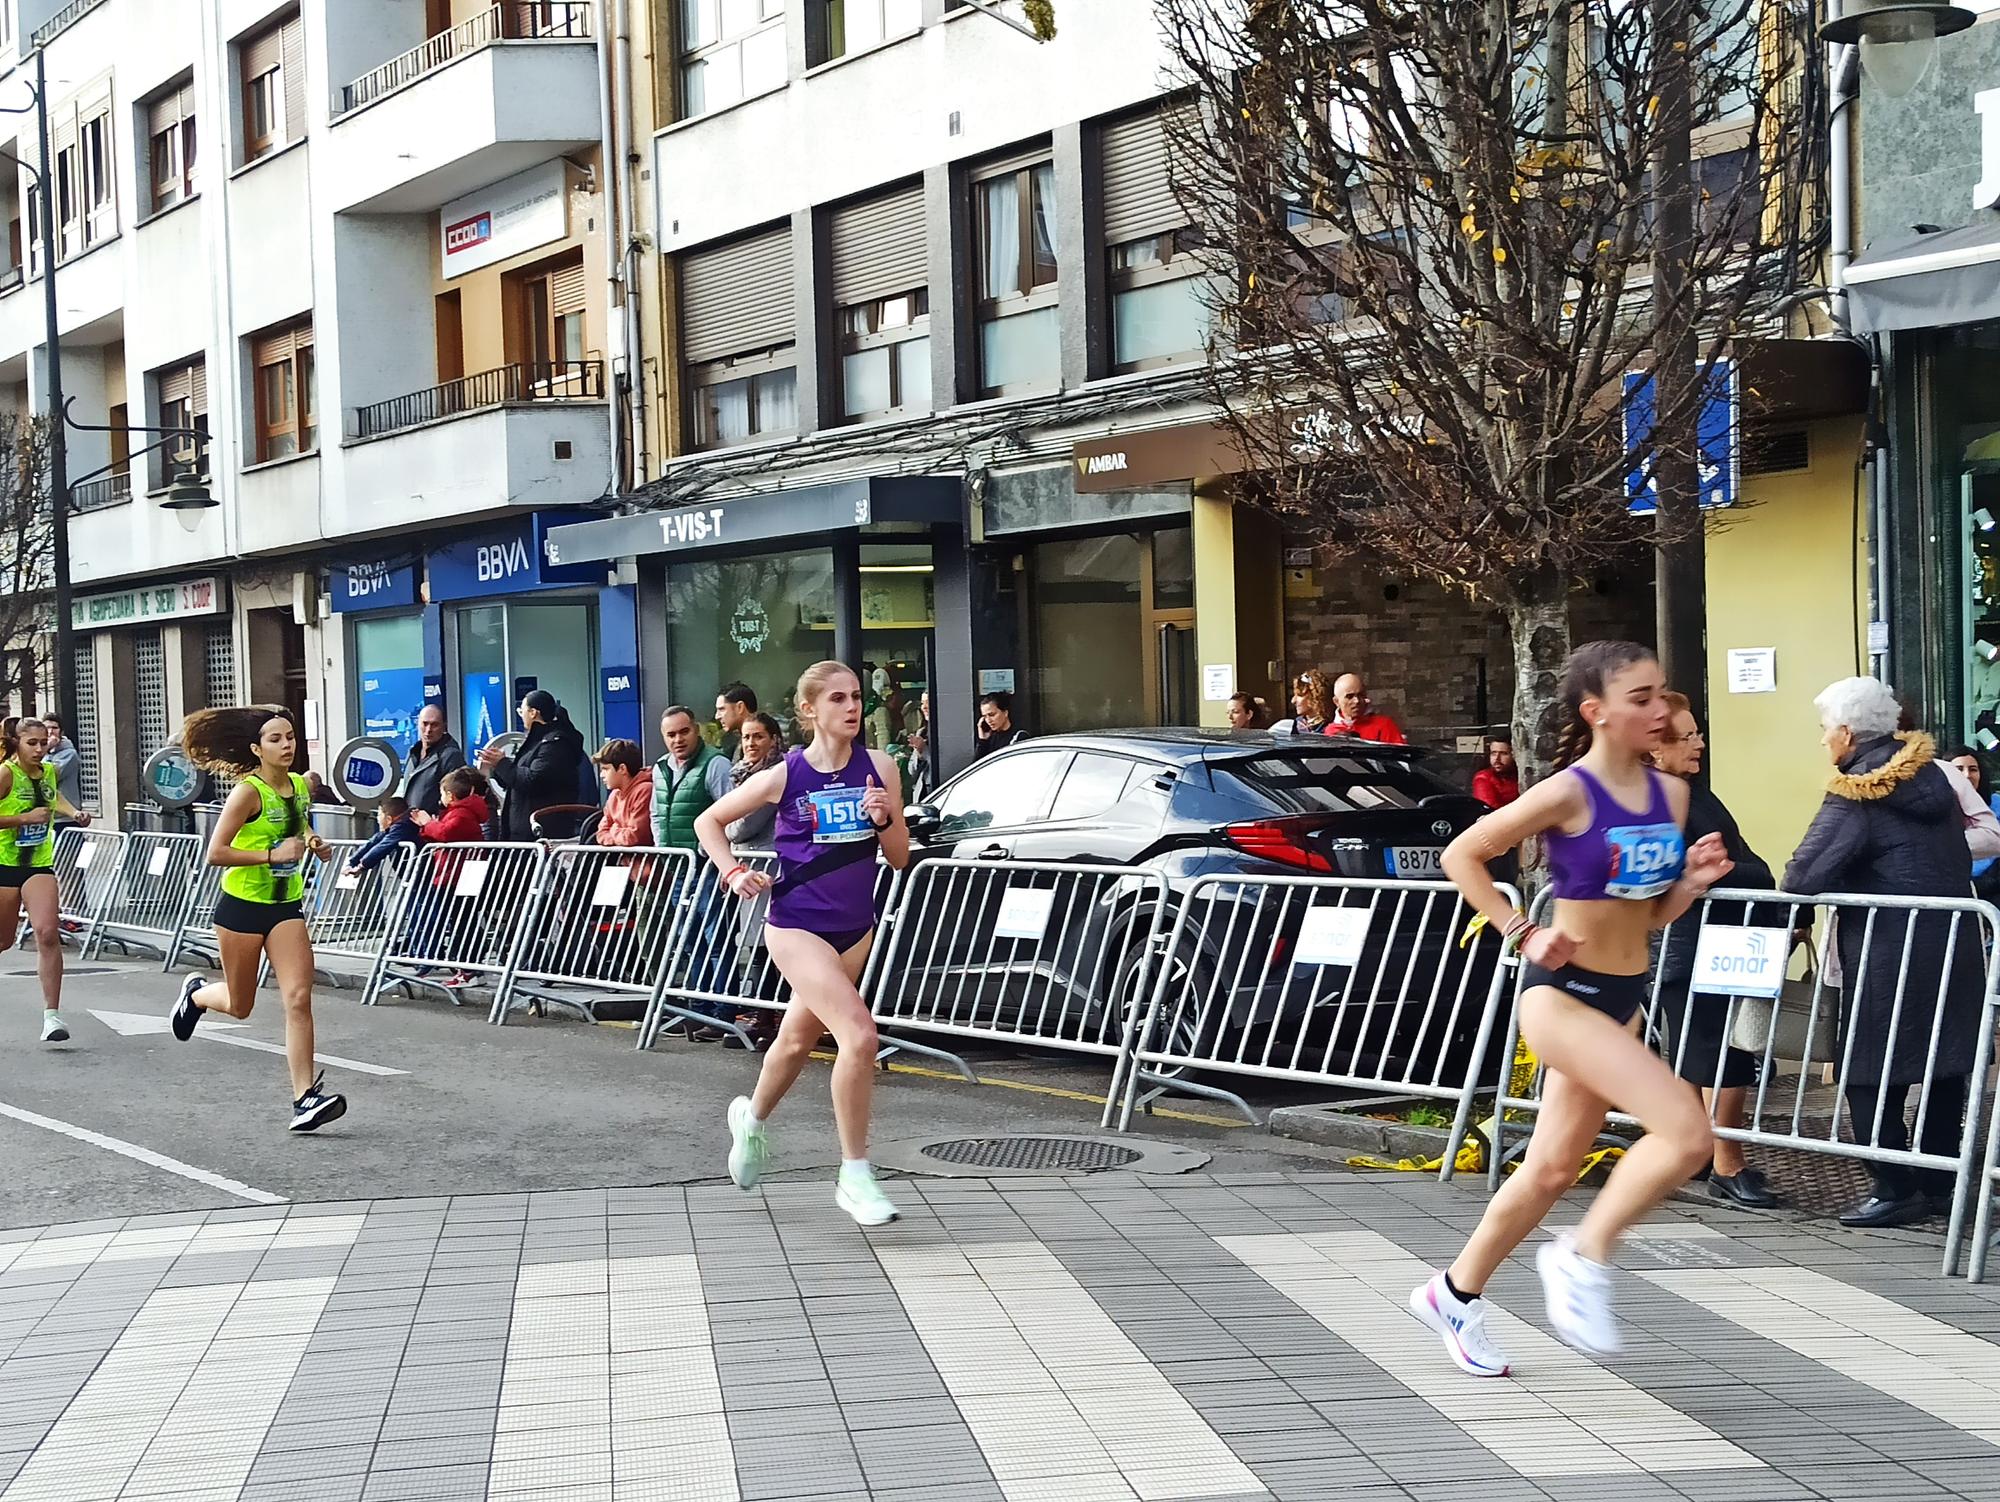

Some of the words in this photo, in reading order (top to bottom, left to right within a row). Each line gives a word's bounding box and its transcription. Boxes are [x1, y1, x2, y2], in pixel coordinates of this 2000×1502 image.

[1088, 452, 1128, 474] AMBAR
[659, 508, 724, 544] T-VIS-T
[477, 537, 528, 582] BBVA
[348, 560, 391, 597] BBVA
[424, 683, 441, 698] BBVA
[607, 675, 630, 691] BBVA
[821, 800, 870, 824] 1518
[22, 822, 48, 836] 1525
[1398, 849, 1442, 870] 8878
[1621, 840, 1681, 873] 1524
[1711, 955, 1769, 974] sonar
